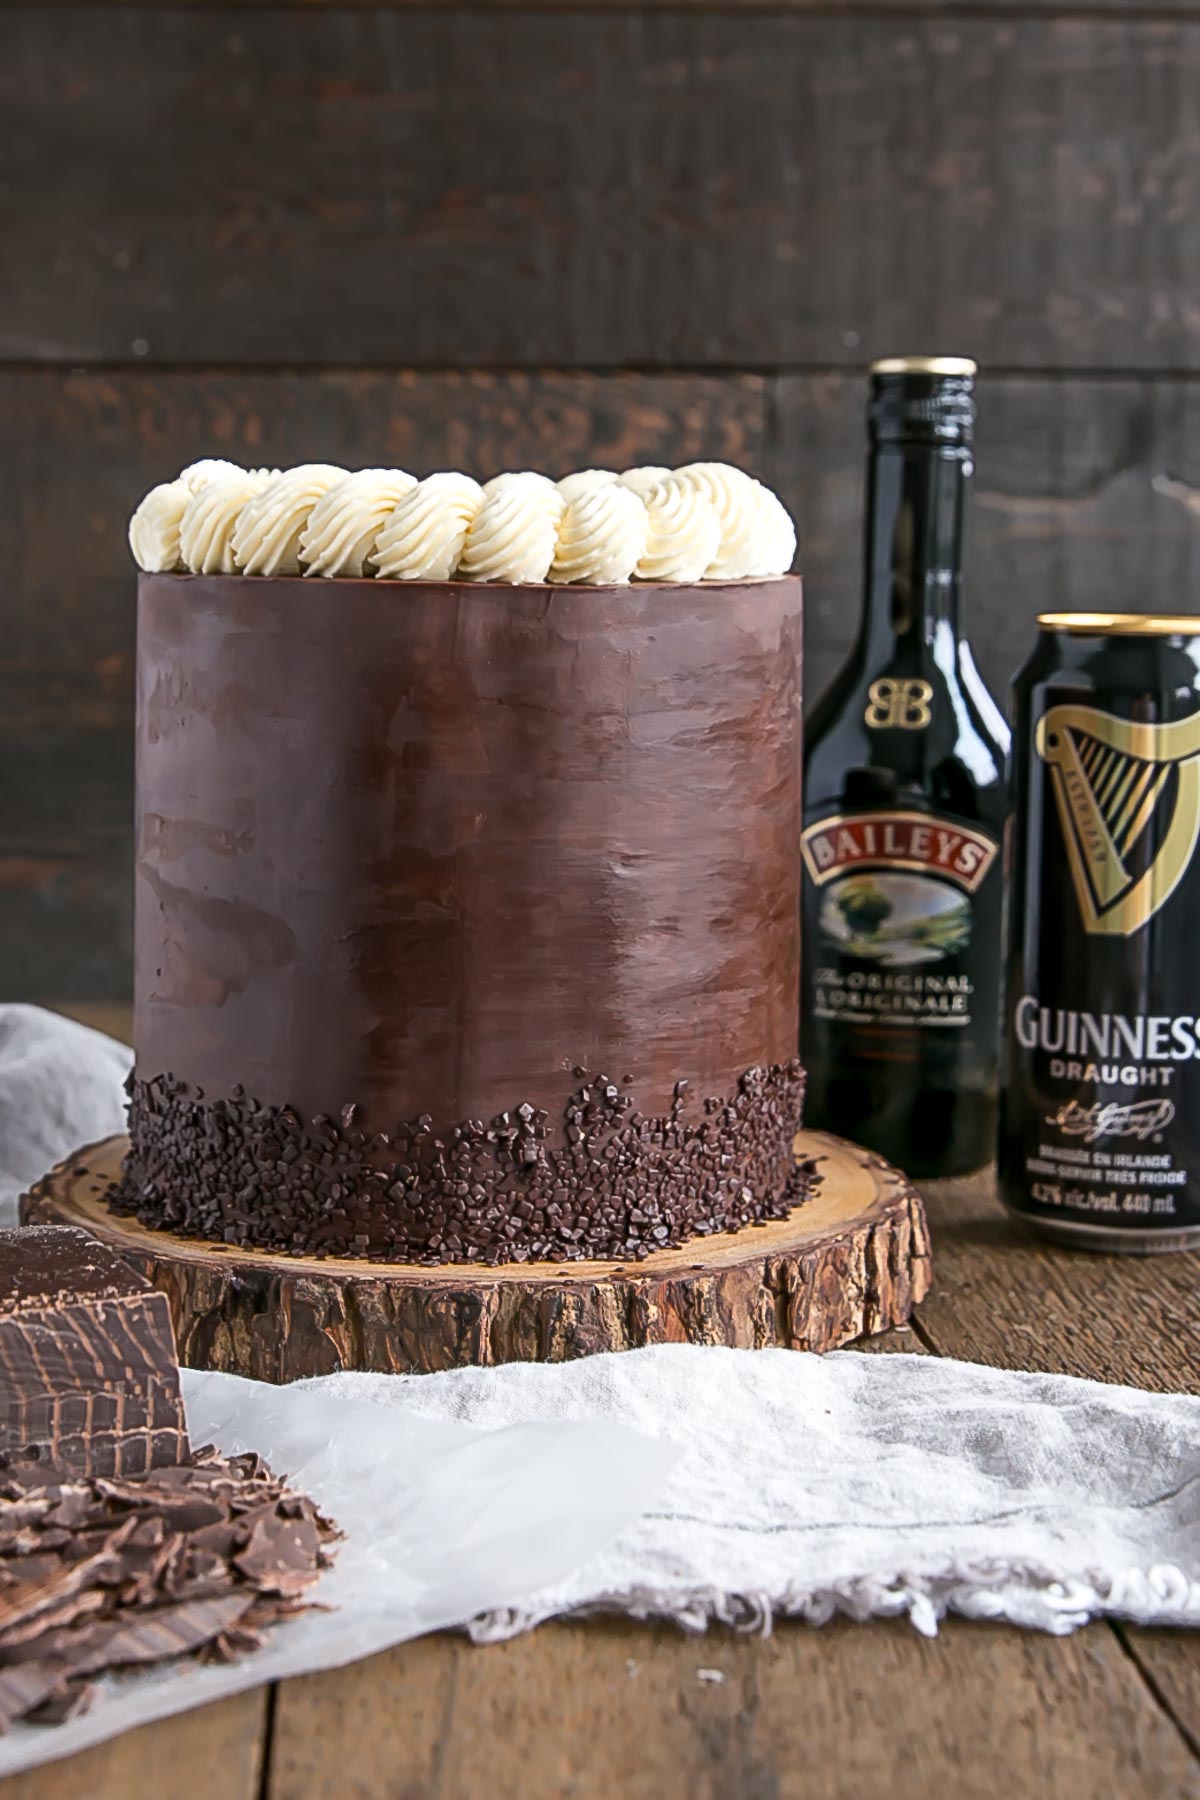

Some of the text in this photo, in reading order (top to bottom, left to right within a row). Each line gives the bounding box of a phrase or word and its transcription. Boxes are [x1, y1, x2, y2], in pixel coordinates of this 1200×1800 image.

[811, 823, 985, 873] BAILEYS
[846, 972, 974, 994] ORIGINAL
[1050, 1058, 1175, 1086] DRAUGHT
